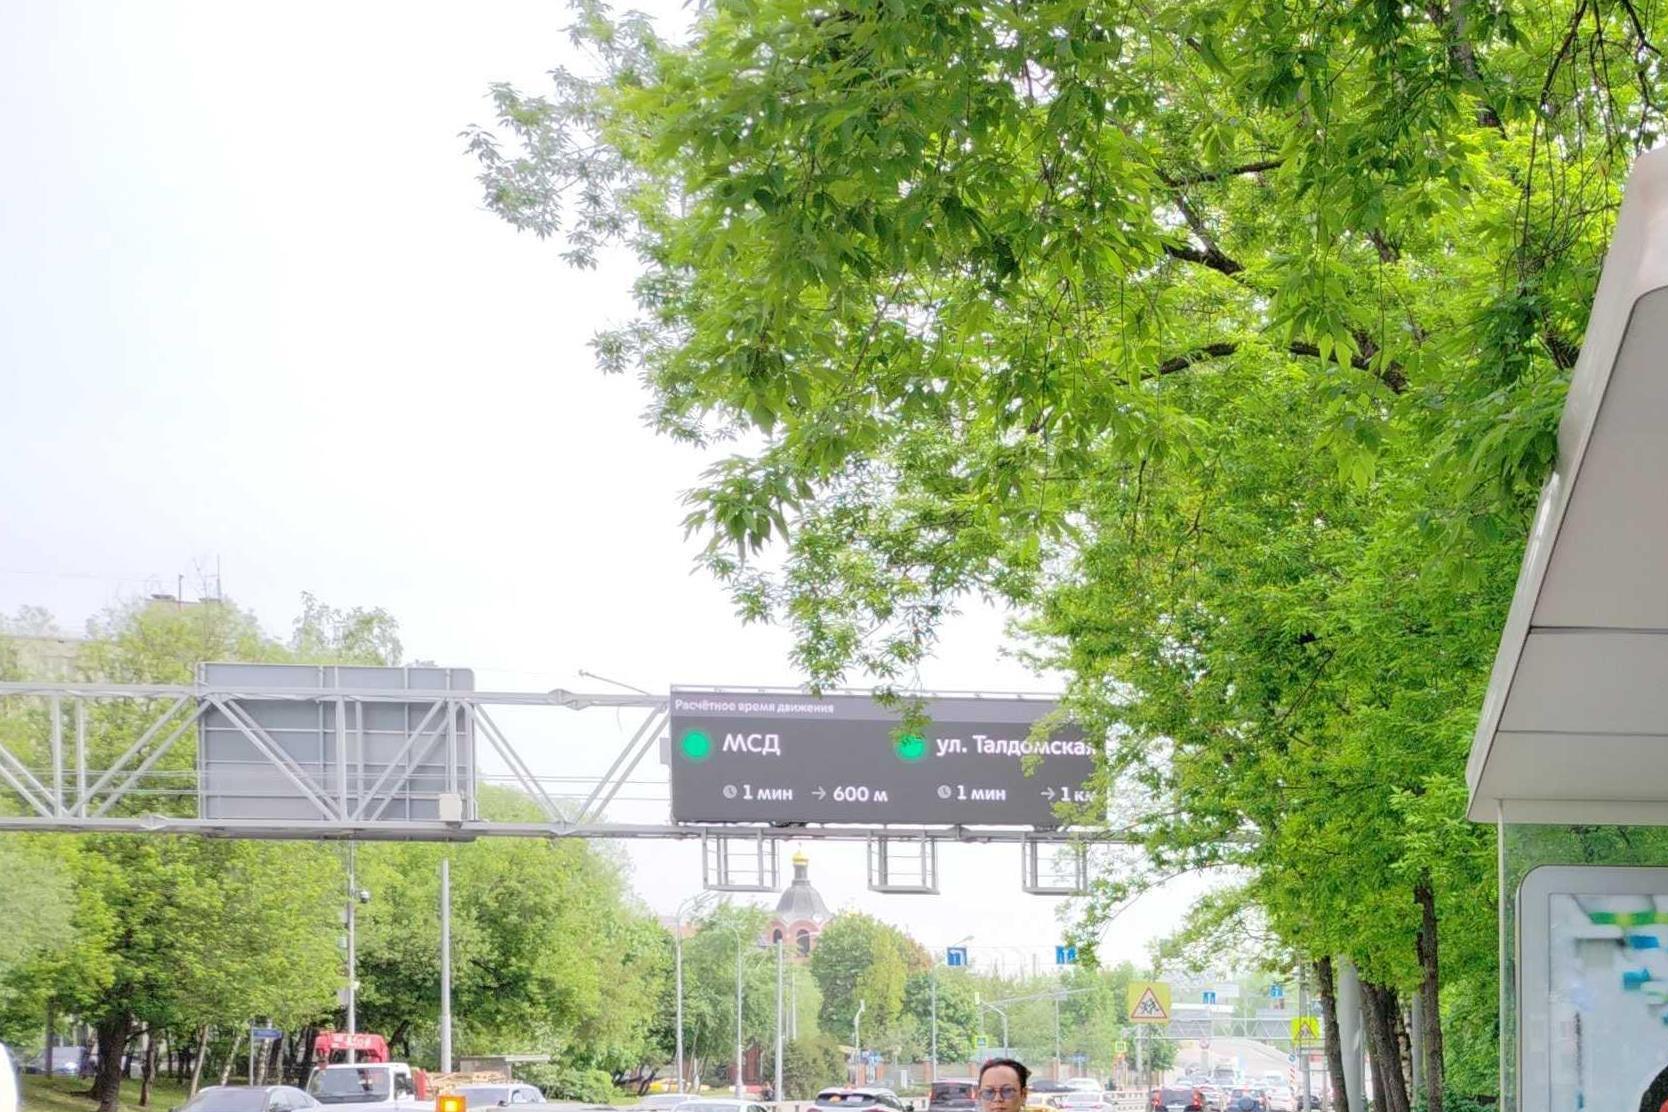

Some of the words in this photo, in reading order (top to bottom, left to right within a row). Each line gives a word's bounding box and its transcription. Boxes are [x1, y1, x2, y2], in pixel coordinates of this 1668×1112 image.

[674, 699, 736, 712] Расчётное
[737, 701, 775, 714] время
[776, 703, 835, 715] движения
[722, 732, 782, 757] МСД
[935, 737, 968, 757] ул.
[742, 784, 754, 801] 1
[757, 786, 793, 801] мин
[832, 785, 870, 802] 600
[873, 788, 889, 803] м
[956, 784, 968, 801] 1
[970, 787, 1007, 801] мин
[1060, 786, 1072, 802] 1
